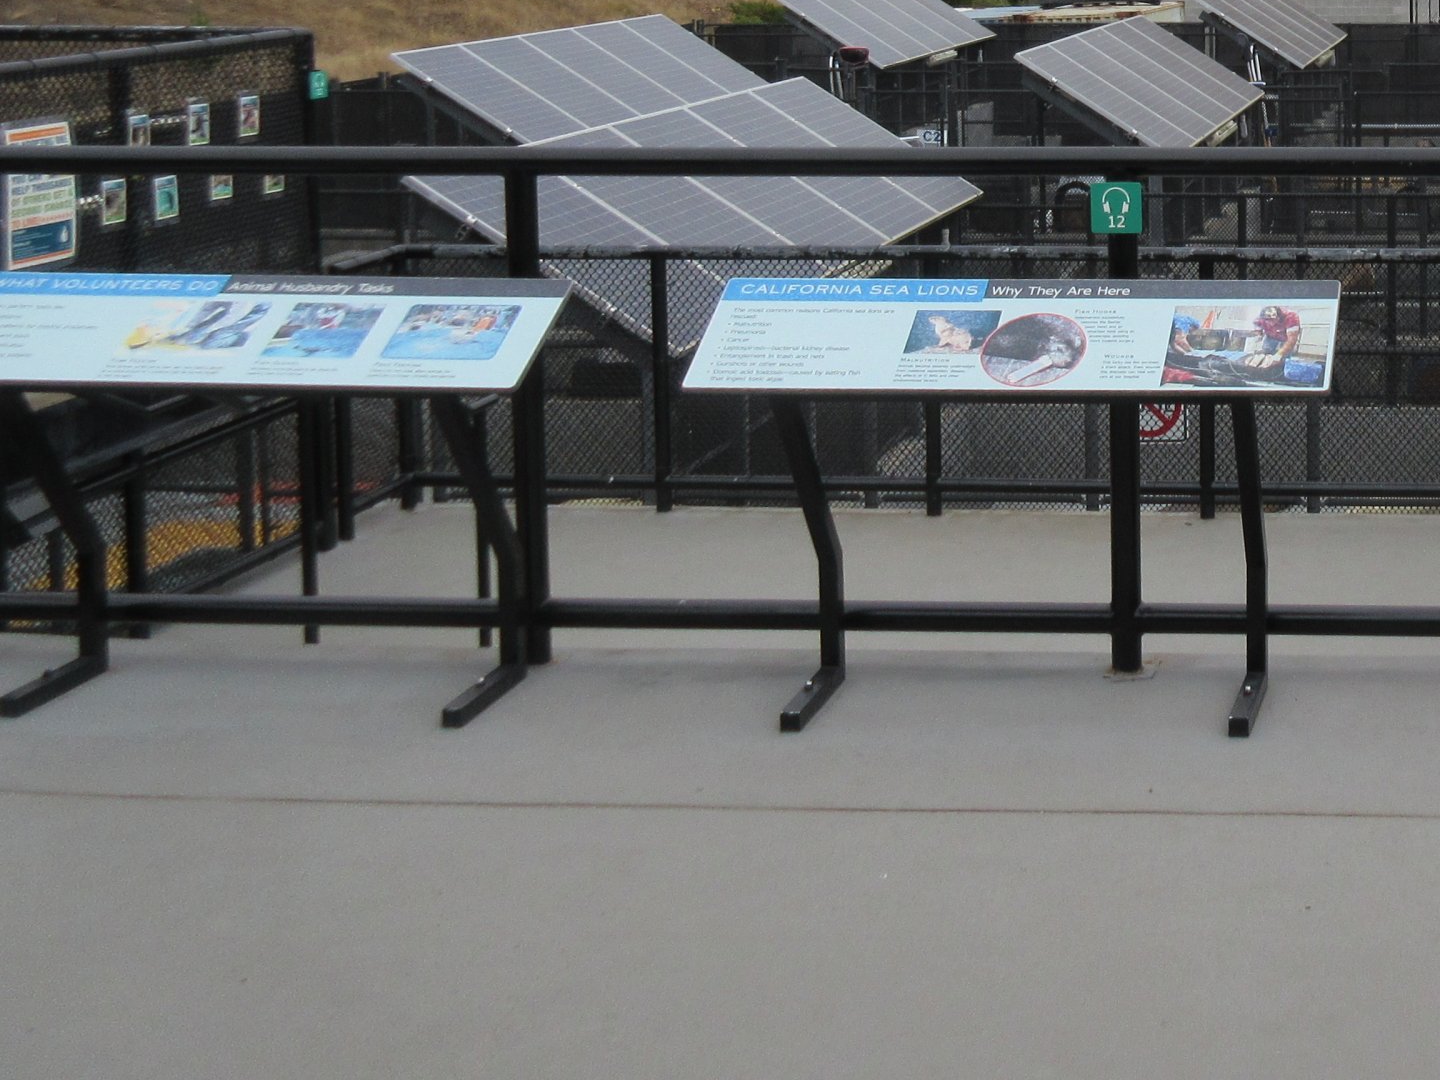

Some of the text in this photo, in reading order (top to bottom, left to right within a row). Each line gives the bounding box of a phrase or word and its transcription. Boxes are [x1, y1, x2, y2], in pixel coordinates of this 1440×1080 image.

[923, 131, 941, 142] C2
[1108, 216, 1125, 228] 12
[53, 279, 183, 290] VOLUNTEERS
[188, 281, 219, 290] DO
[228, 281, 394, 295] Animal Husbandry Tasks
[742, 283, 979, 296] CALIFORNIA SEA LIONS
[992, 286, 1131, 298] Why They Are Here
